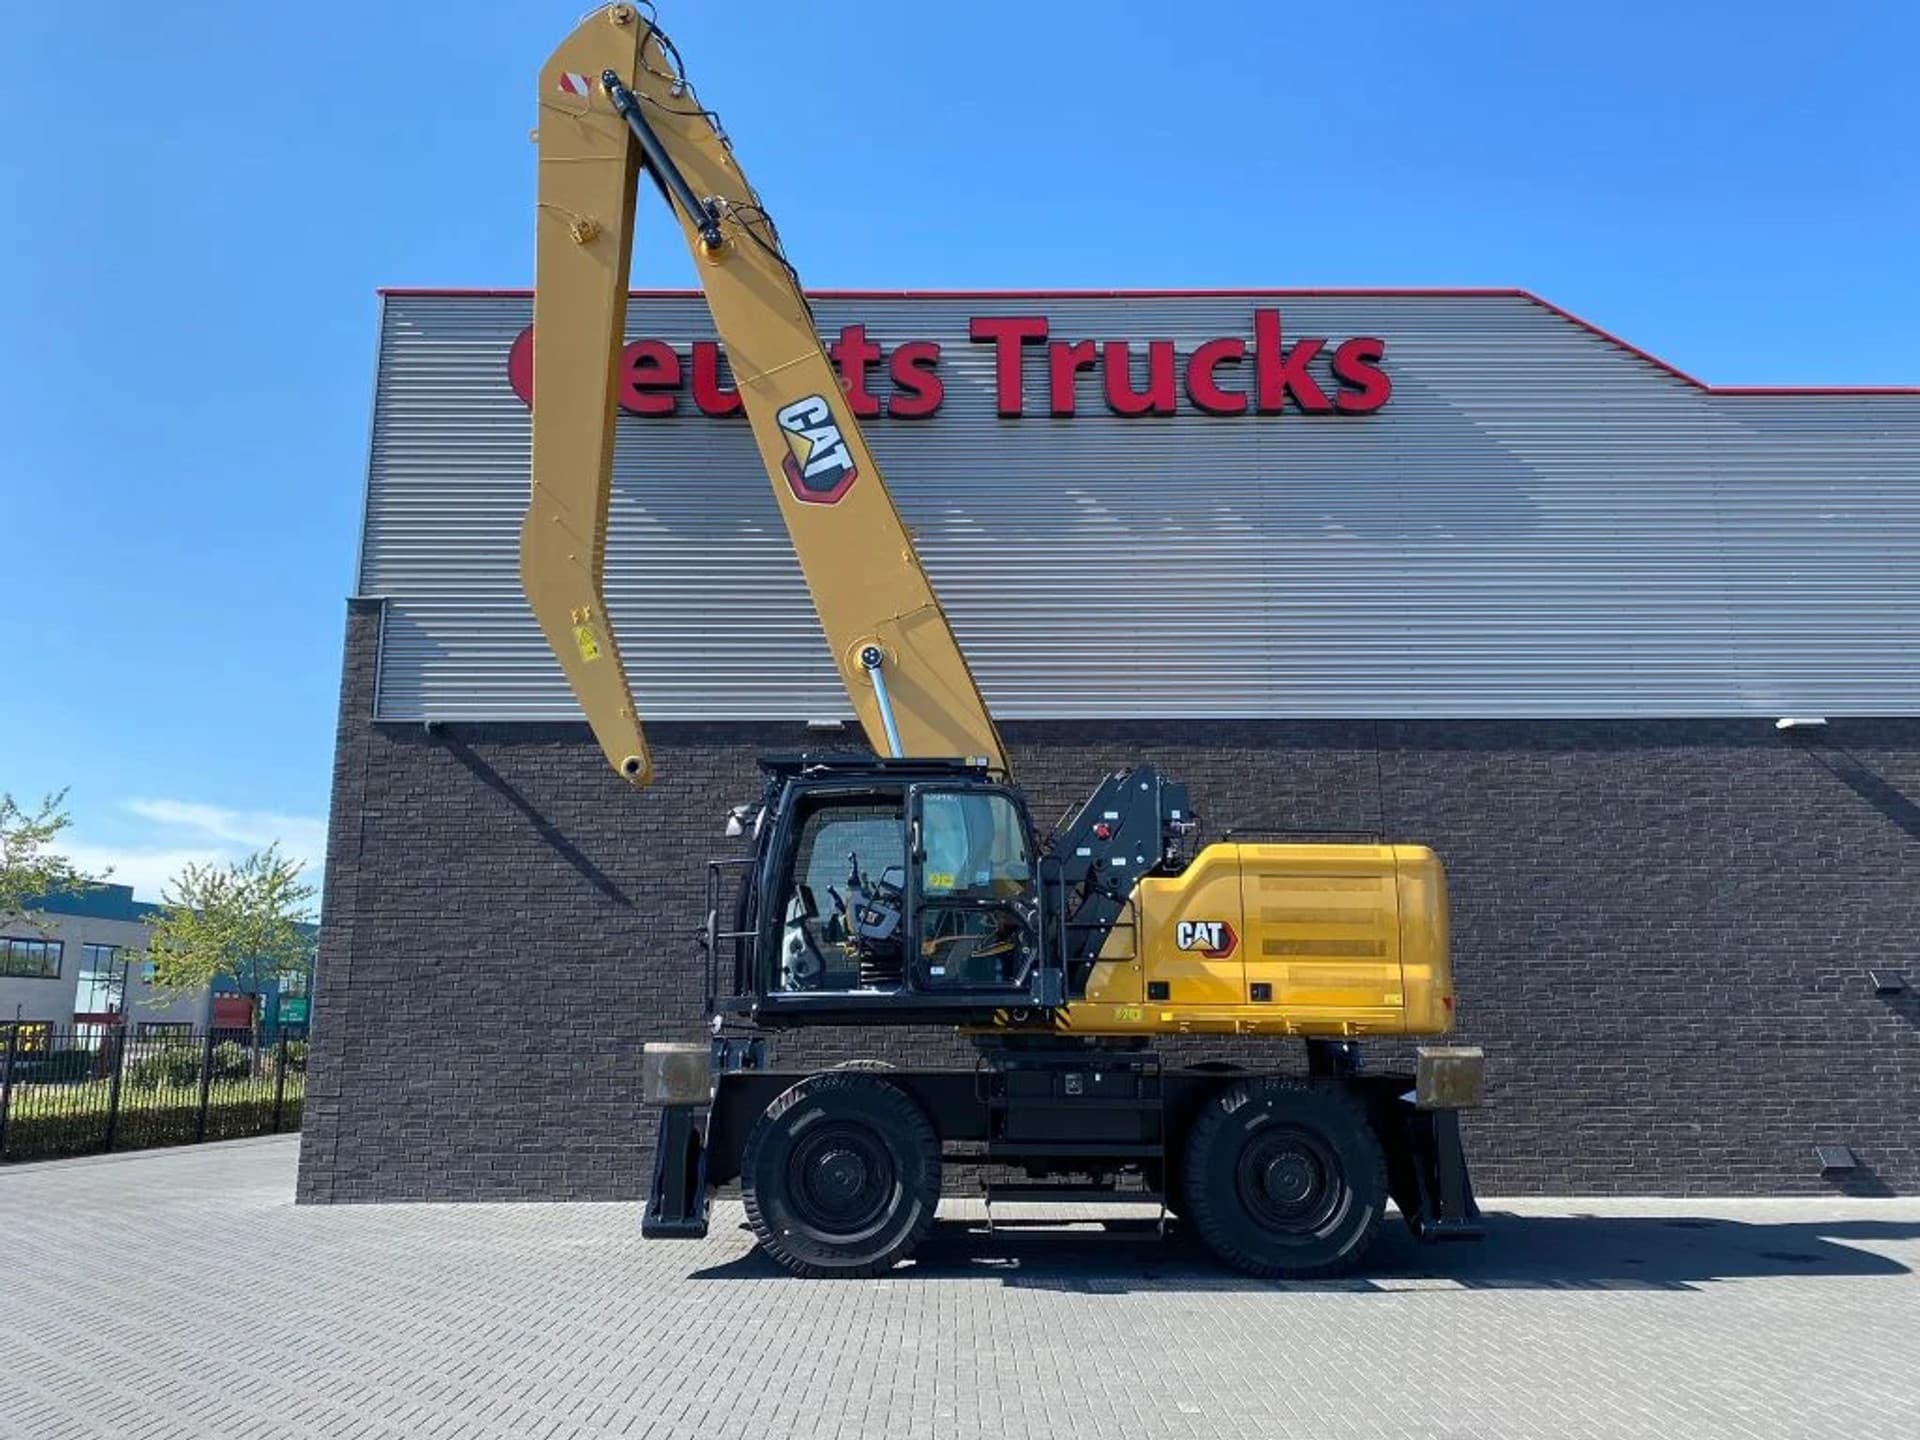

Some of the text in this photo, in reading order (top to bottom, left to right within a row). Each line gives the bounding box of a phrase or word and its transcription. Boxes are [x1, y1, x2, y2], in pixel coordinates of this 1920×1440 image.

[508, 308, 1393, 418] euts Trucks
[777, 394, 855, 478] CAT
[1176, 921, 1223, 951] CAT
